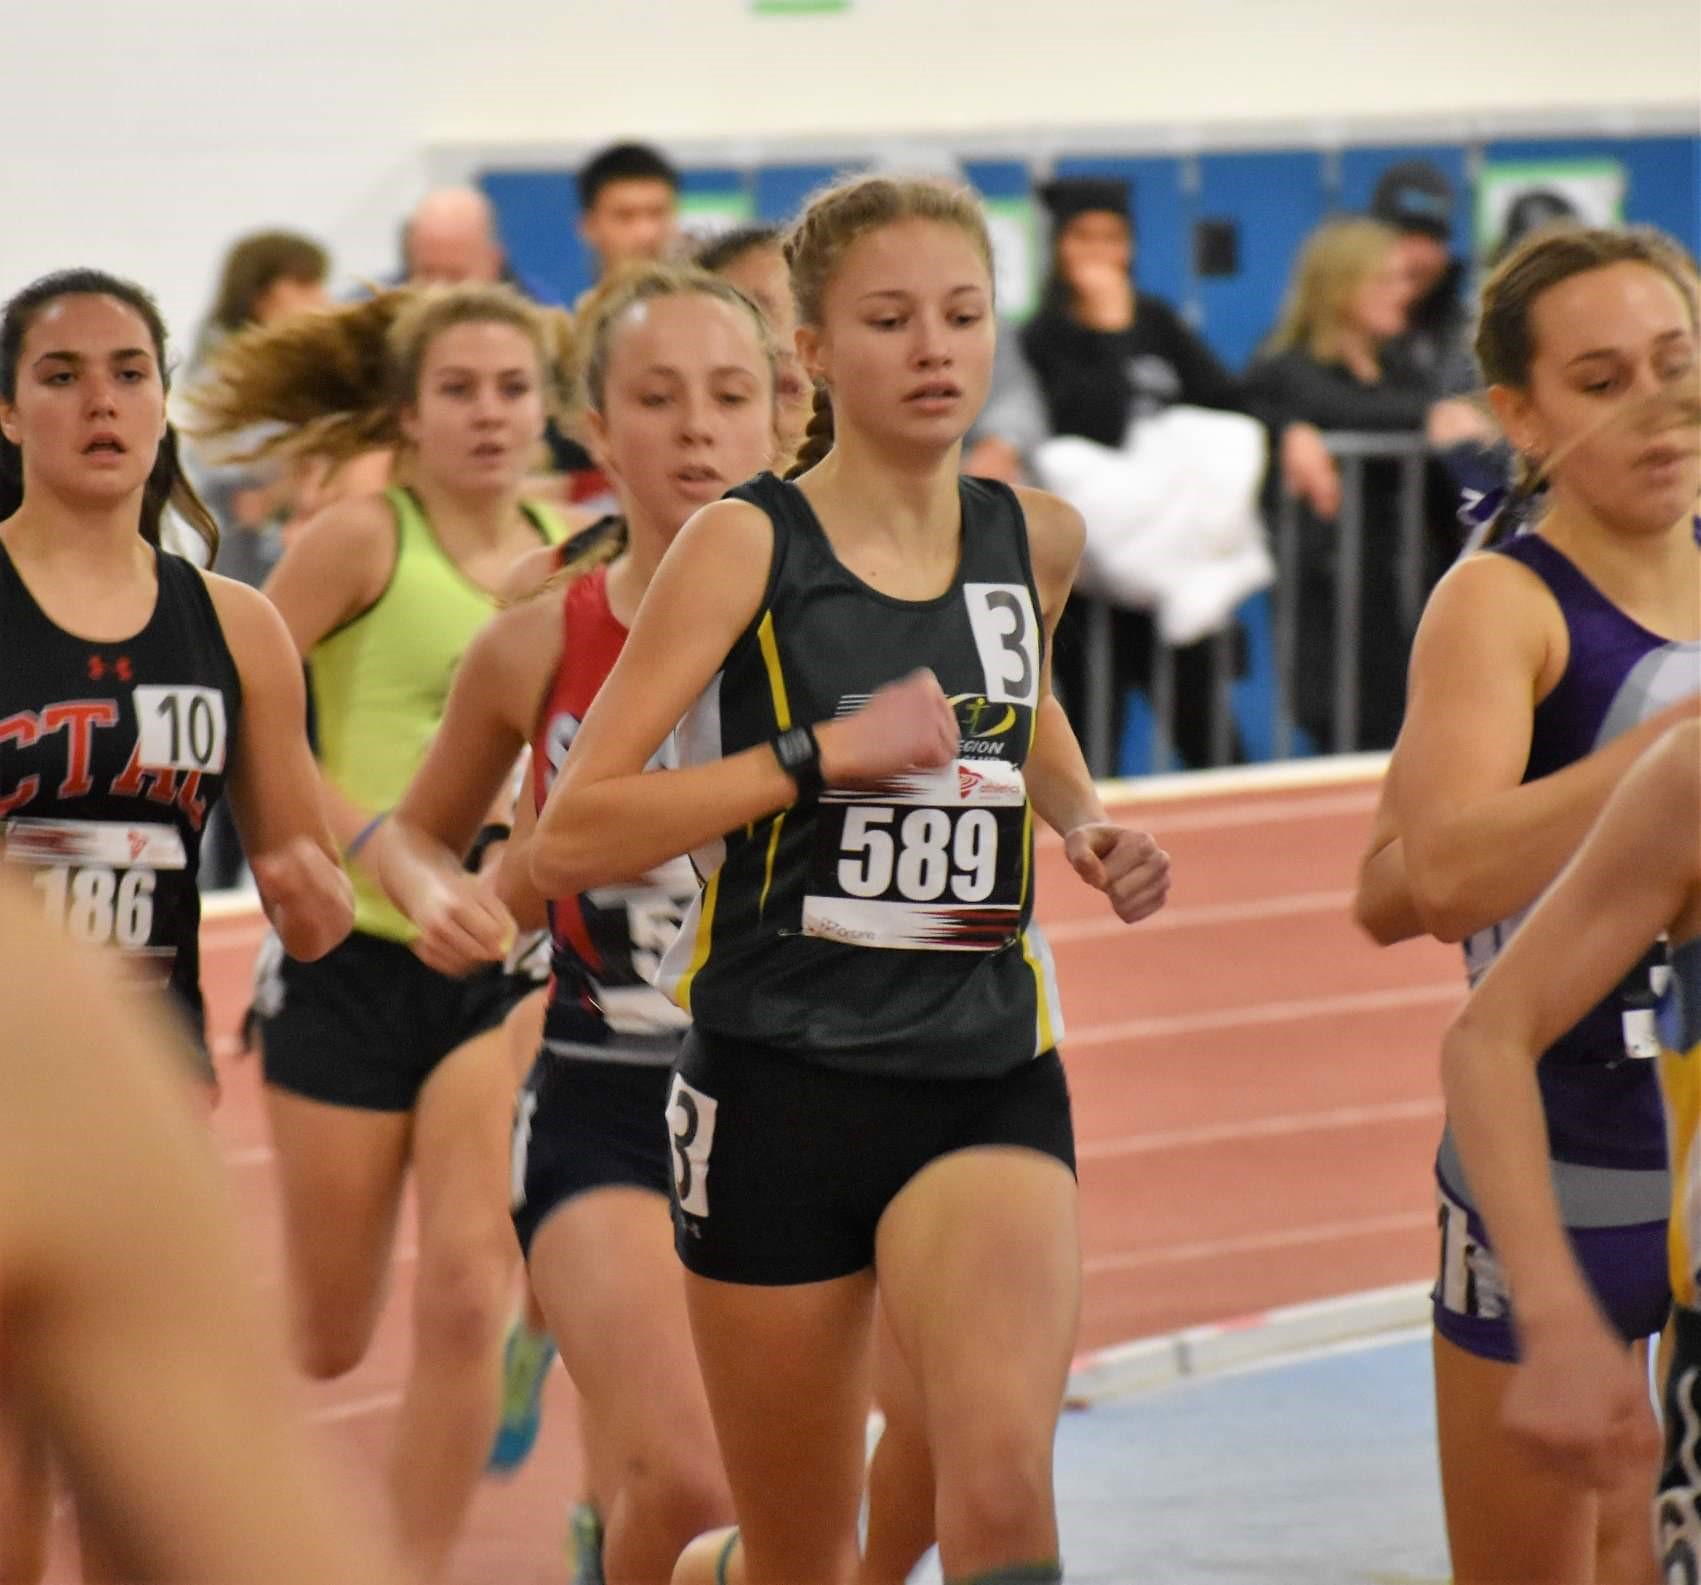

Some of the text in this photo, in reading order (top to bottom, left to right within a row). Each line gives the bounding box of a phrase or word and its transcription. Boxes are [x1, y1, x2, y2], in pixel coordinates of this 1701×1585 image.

[986, 590, 1033, 699] 3
[158, 693, 214, 766] 10
[957, 739, 1005, 754] EGION
[837, 806, 998, 902] 589
[33, 866, 157, 947] 186
[674, 1090, 699, 1201] 3
